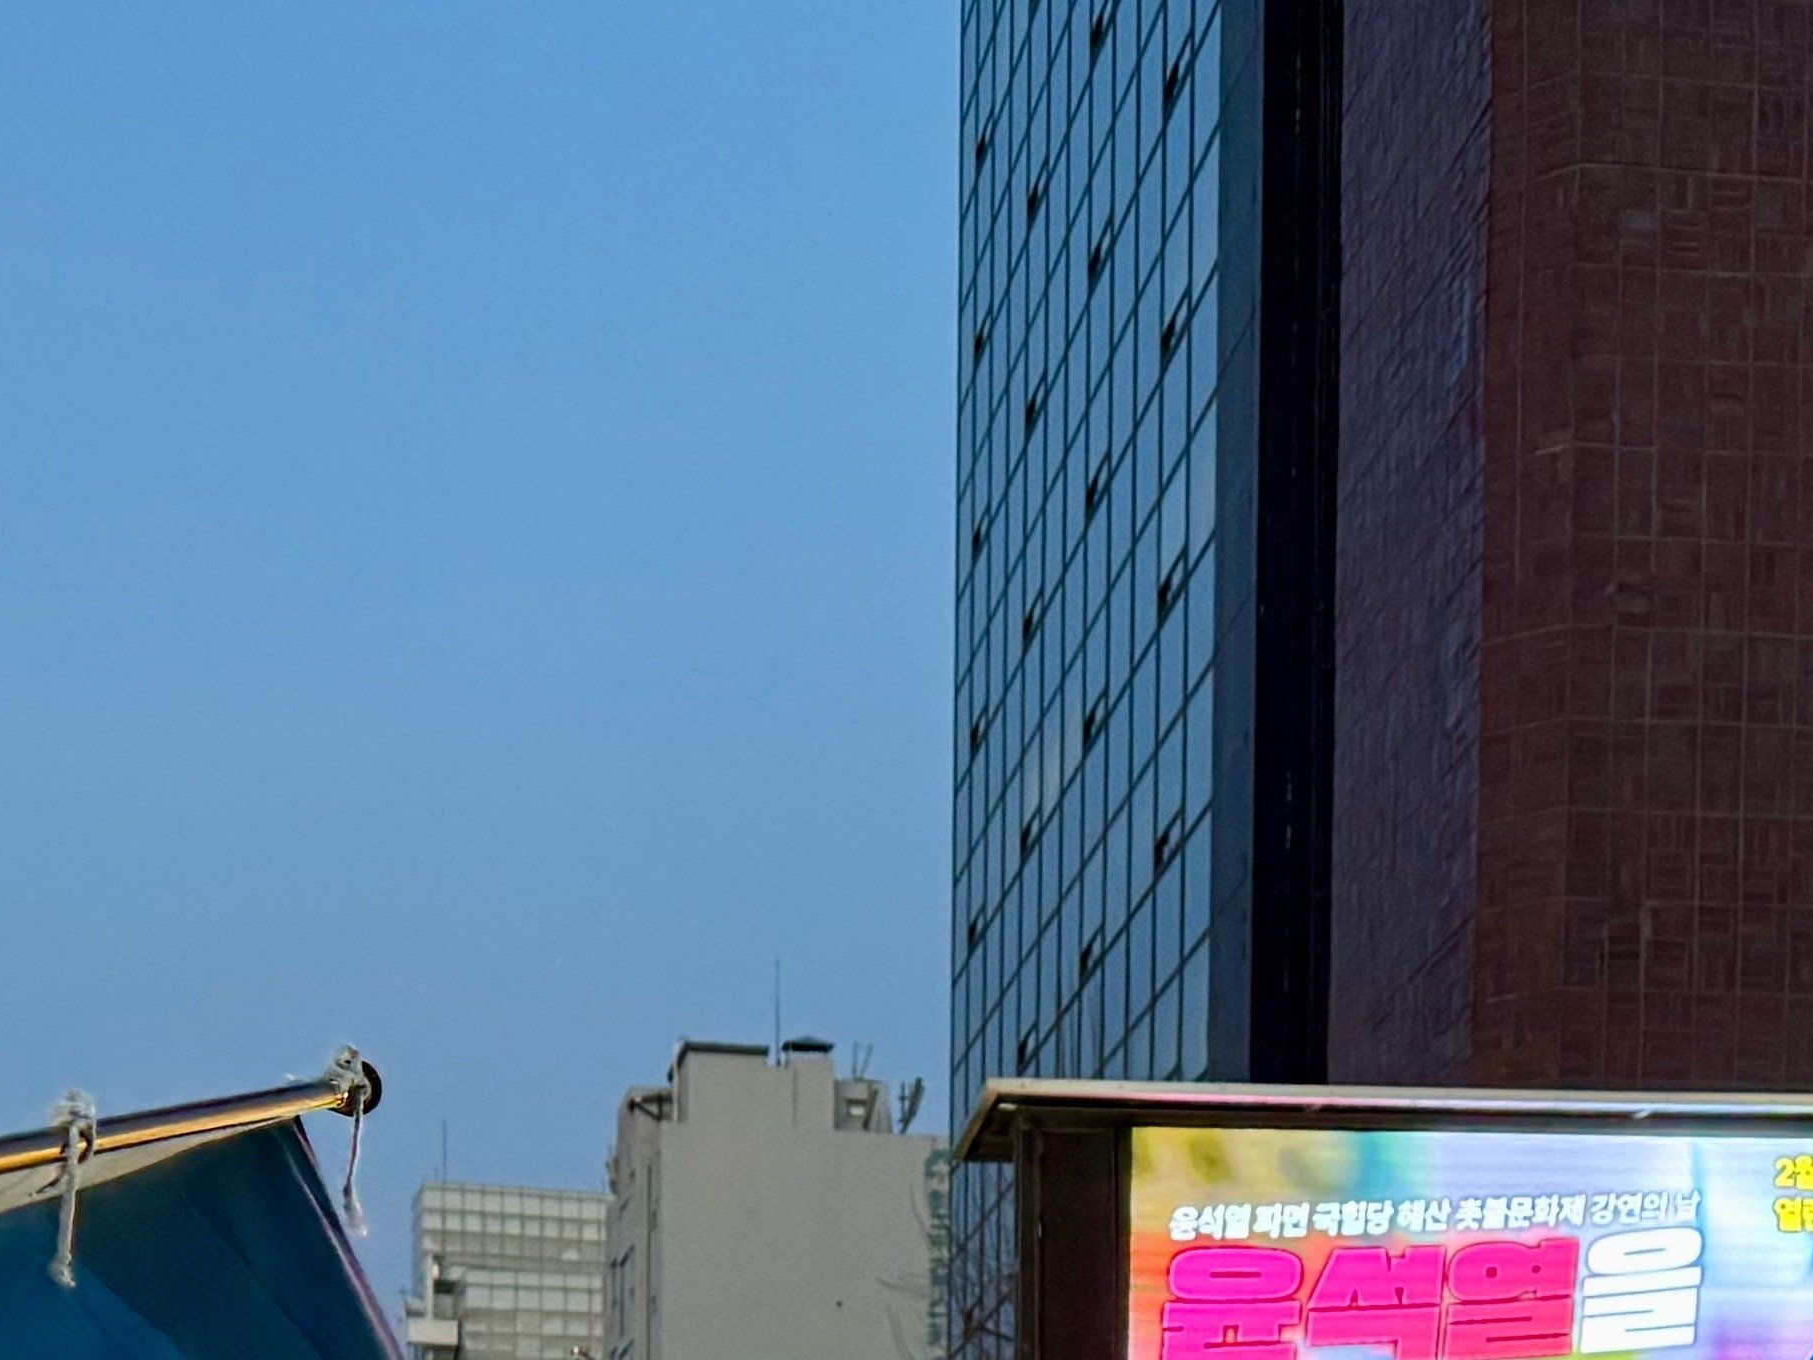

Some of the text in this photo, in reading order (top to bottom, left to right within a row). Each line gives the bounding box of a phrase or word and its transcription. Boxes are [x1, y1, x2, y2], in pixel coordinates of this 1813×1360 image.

[1312, 1199, 1395, 1237] 국힘당
[1397, 1197, 1451, 1232] 해산
[1455, 1194, 1586, 1229] 촛불문화제
[1590, 1192, 1669, 1225] 강연의
